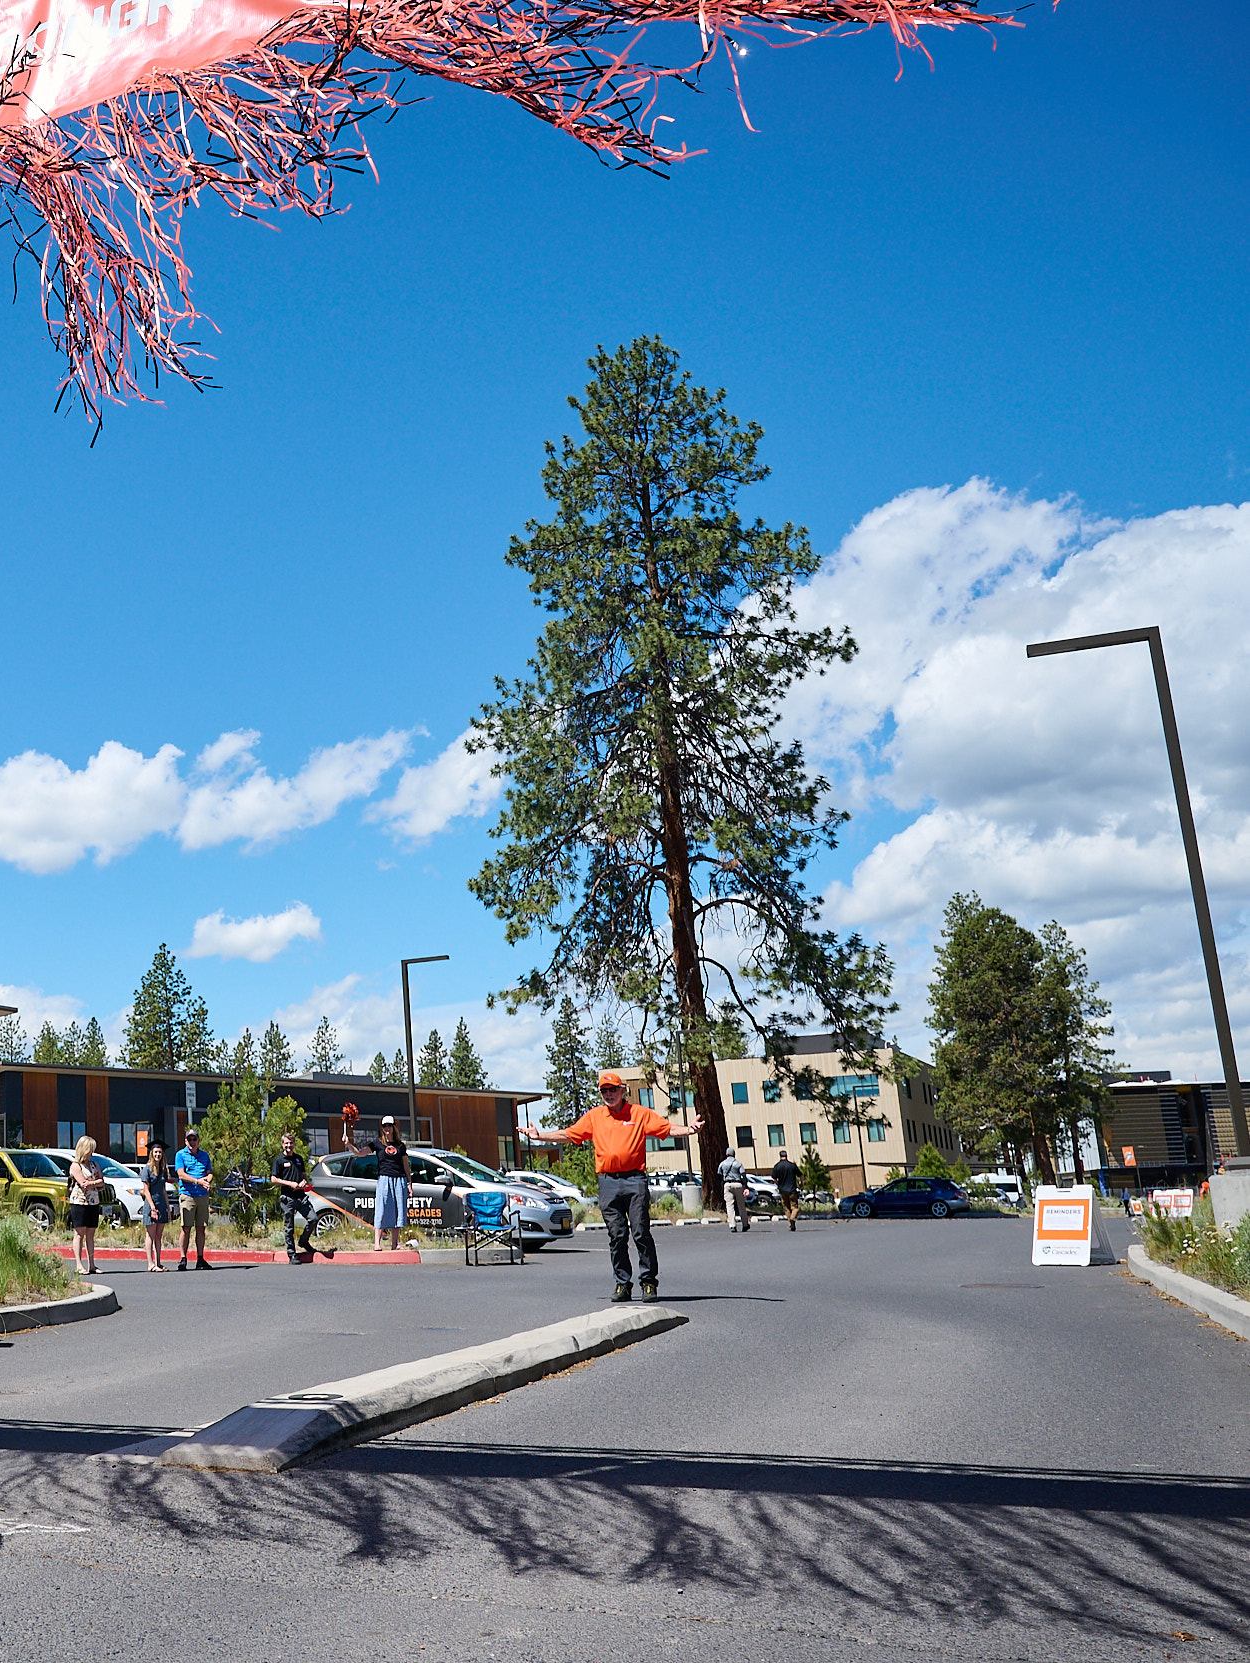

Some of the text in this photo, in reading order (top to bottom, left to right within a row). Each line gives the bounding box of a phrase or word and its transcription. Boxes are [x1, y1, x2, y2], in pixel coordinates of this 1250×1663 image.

[355, 1197, 432, 1208] PUB FETY
[406, 1208, 442, 1218] SCADES
